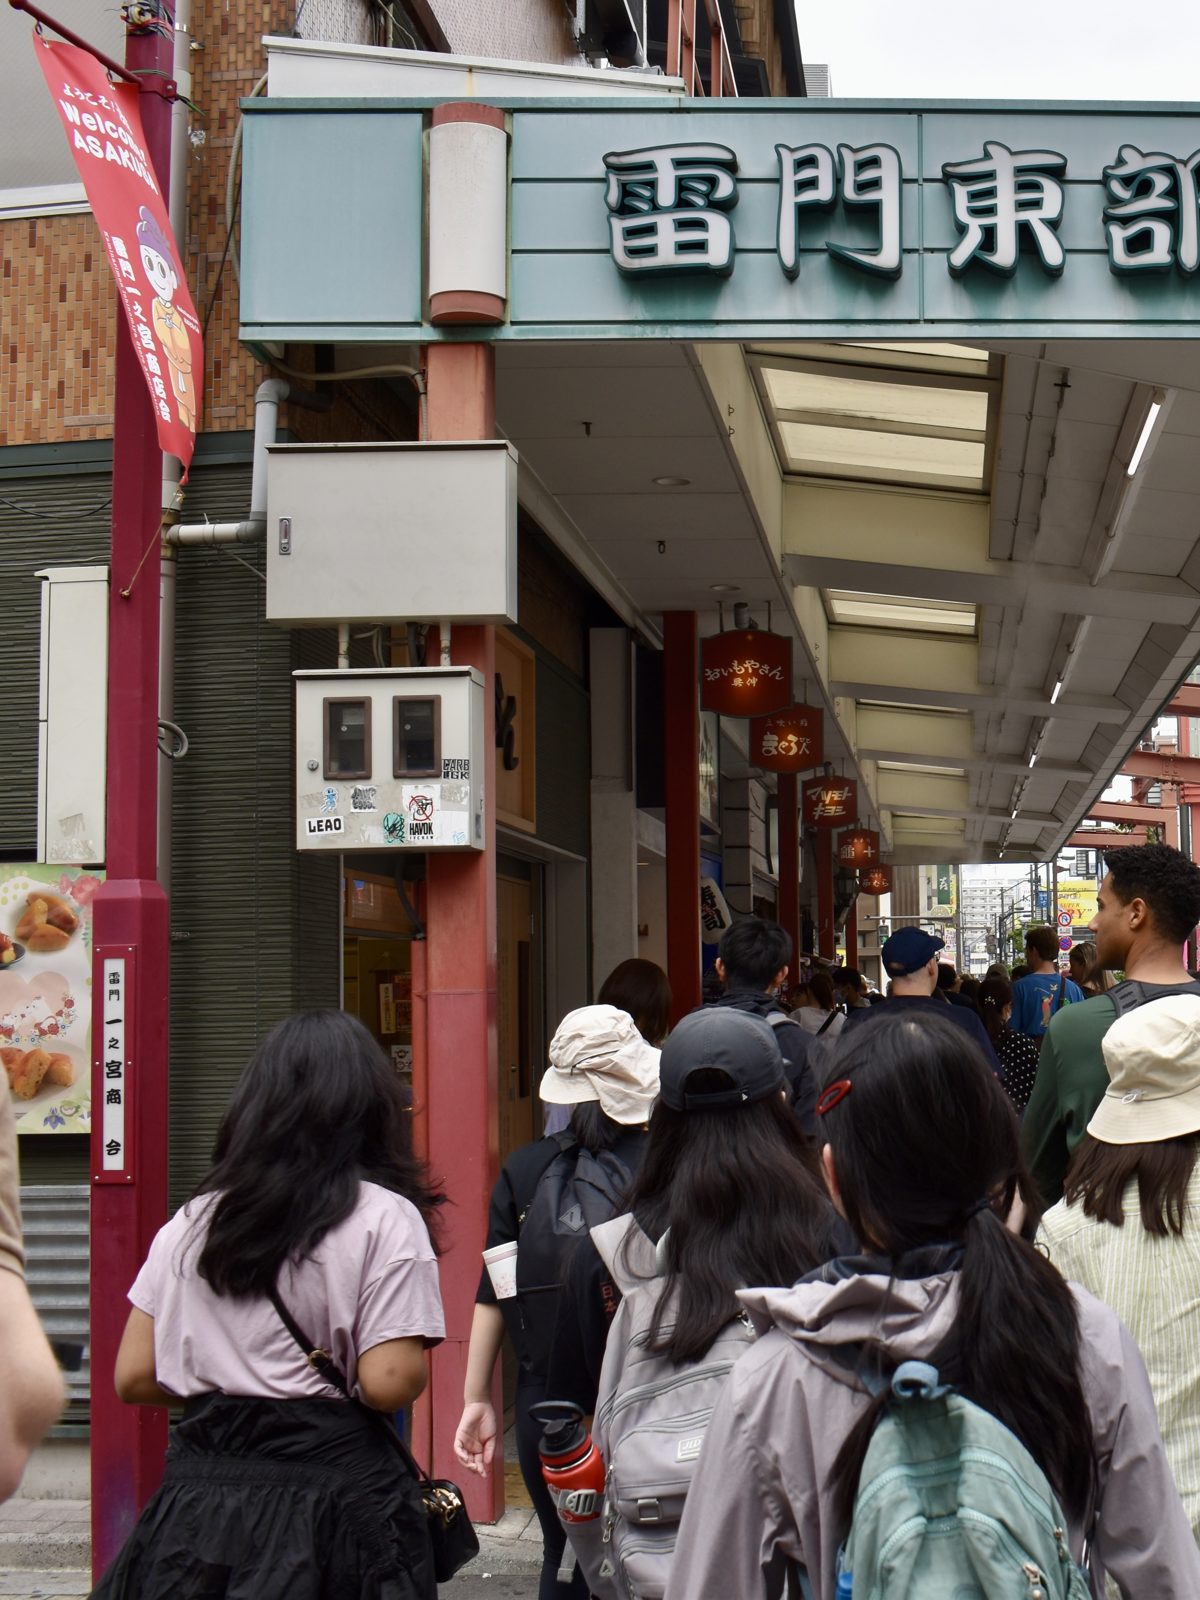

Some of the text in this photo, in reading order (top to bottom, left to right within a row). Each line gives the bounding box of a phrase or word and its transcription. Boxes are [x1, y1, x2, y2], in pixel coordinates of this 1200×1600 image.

[704, 659, 784, 681] おいもやさん
[806, 786, 853, 805] マツモト
[813, 803, 847, 820] キヨシ
[308, 818, 342, 833] LEAO
[409, 822, 434, 836] HAVOK
